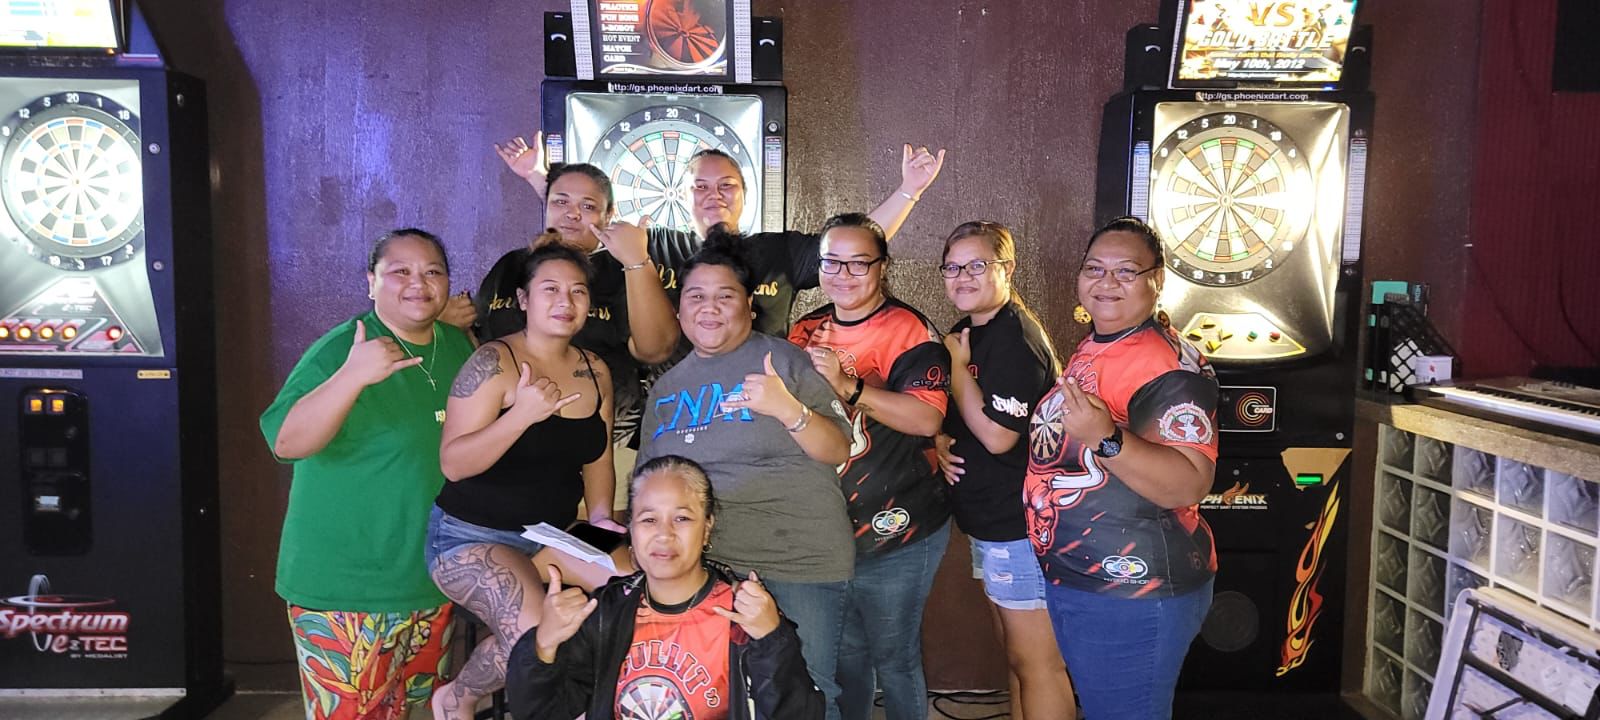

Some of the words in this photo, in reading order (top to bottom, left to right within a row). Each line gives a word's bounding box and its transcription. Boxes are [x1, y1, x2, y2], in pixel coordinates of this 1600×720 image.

[1249, 2, 1296, 27] VS
[1199, 31, 1250, 48] GOLD
[1254, 31, 1335, 48] BATTLE
[1213, 58, 1240, 70] May
[1273, 58, 1306, 68] 2012
[44, 97, 51, 107] 5
[66, 93, 80, 103] 20
[96, 98, 102, 108] 1
[20, 108, 30, 118] 12
[644, 112, 651, 121] 5
[666, 108, 678, 118] 20
[695, 114, 700, 122] 1
[1202, 118, 1209, 128] 5
[1224, 115, 1236, 125] 20
[1252, 120, 1258, 129] 1
[620, 122, 631, 132] 12
[1177, 130, 1188, 140] 12
[1288, 148, 1296, 158] 4
[100, 255, 112, 266] 17
[1174, 258, 1181, 269] 7
[1265, 259, 1273, 270] 2
[1217, 274, 1226, 284] 3
[1242, 270, 1254, 280] 17
[1200, 490, 1268, 505] PHOENIX
[0, 609, 129, 637] Spectrum
